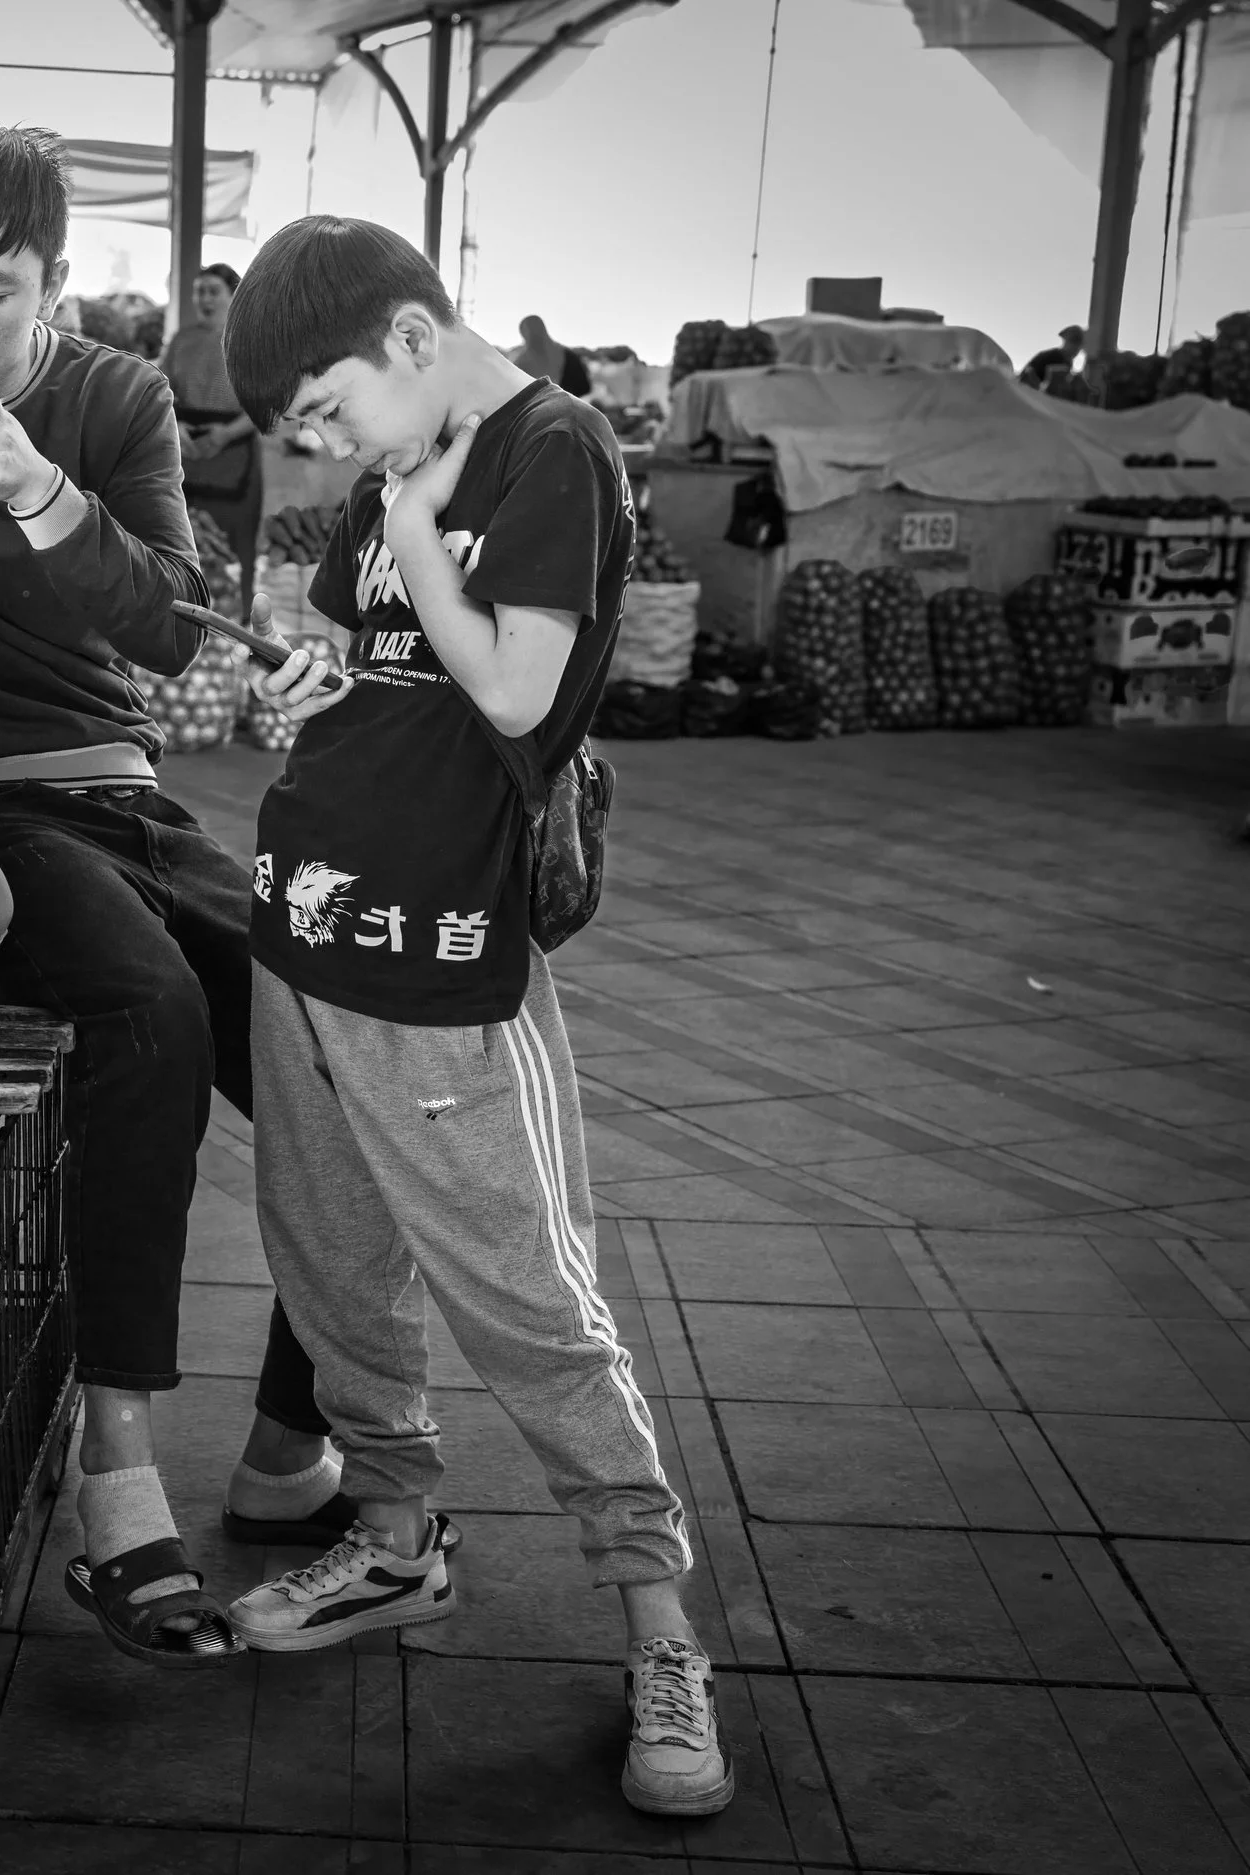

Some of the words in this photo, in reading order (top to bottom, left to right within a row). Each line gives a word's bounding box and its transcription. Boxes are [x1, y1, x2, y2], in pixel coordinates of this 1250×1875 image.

[905, 517, 952, 546] 2169
[369, 631, 422, 661] KAZE
[403, 669, 437, 682] OPENING
[417, 1097, 456, 1109] Reebok
